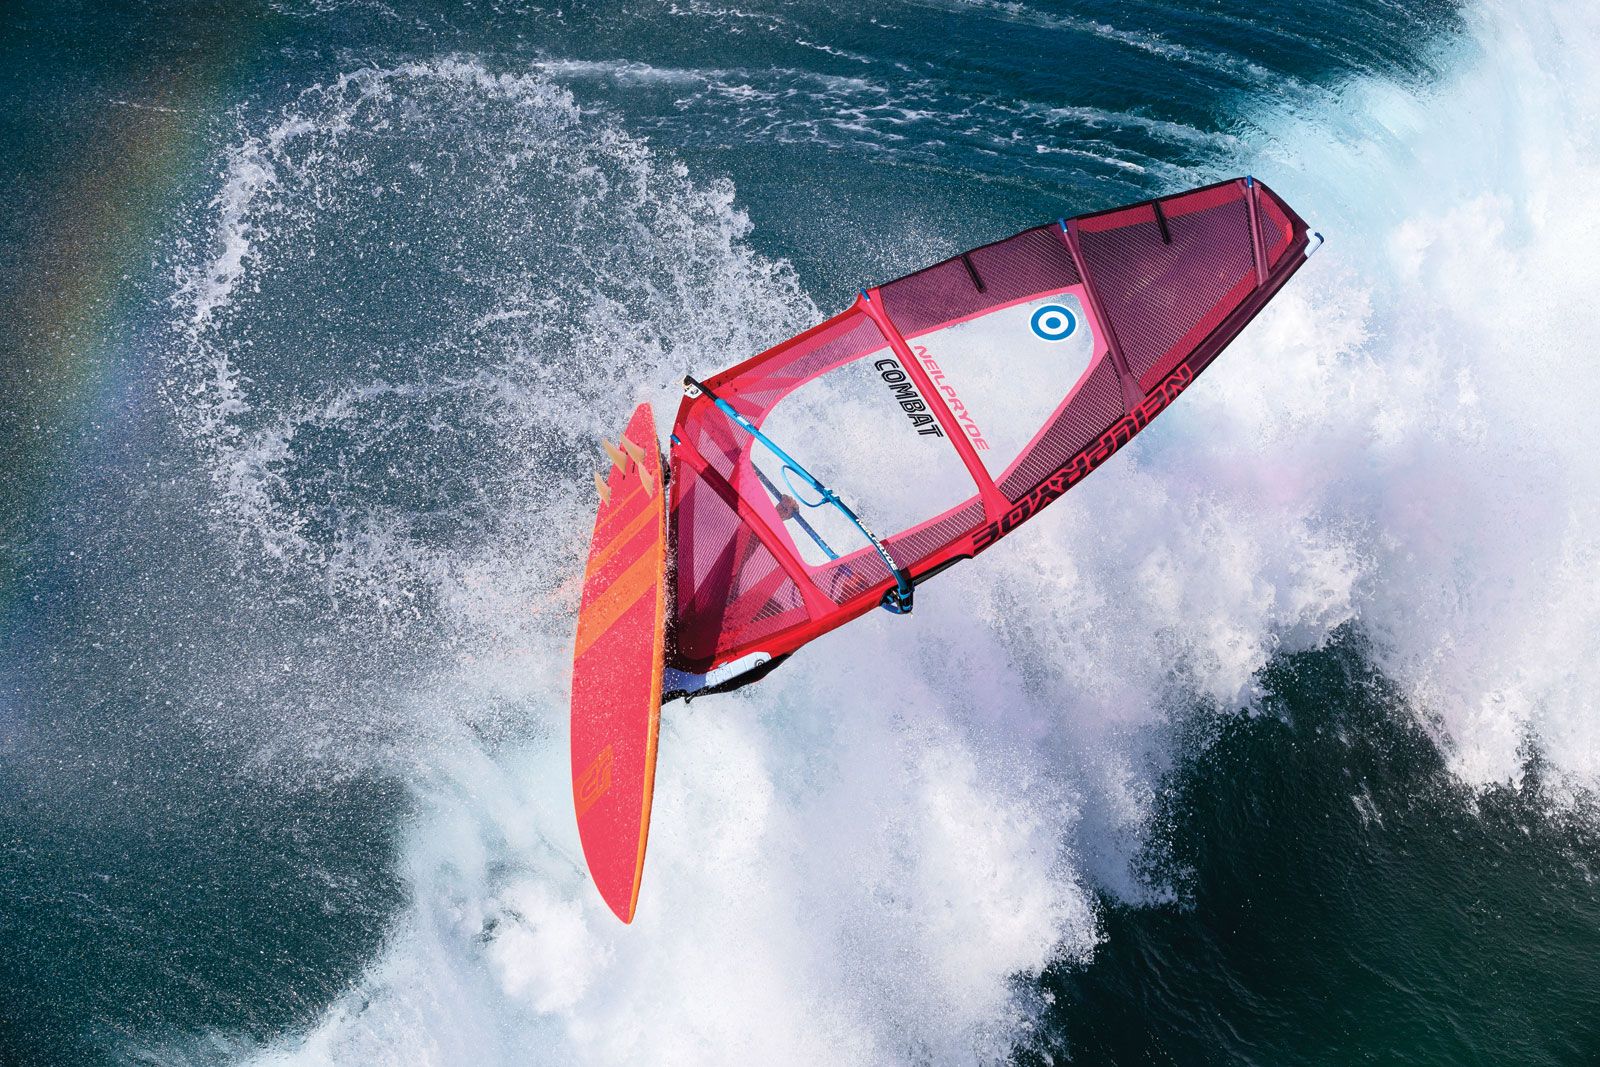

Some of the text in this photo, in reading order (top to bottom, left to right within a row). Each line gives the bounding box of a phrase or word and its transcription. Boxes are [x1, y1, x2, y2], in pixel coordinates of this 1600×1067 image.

[874, 358, 944, 438] COMBAT
[913, 345, 990, 451] NEILPRYDE
[971, 362, 1195, 552] NEILPRYDE
